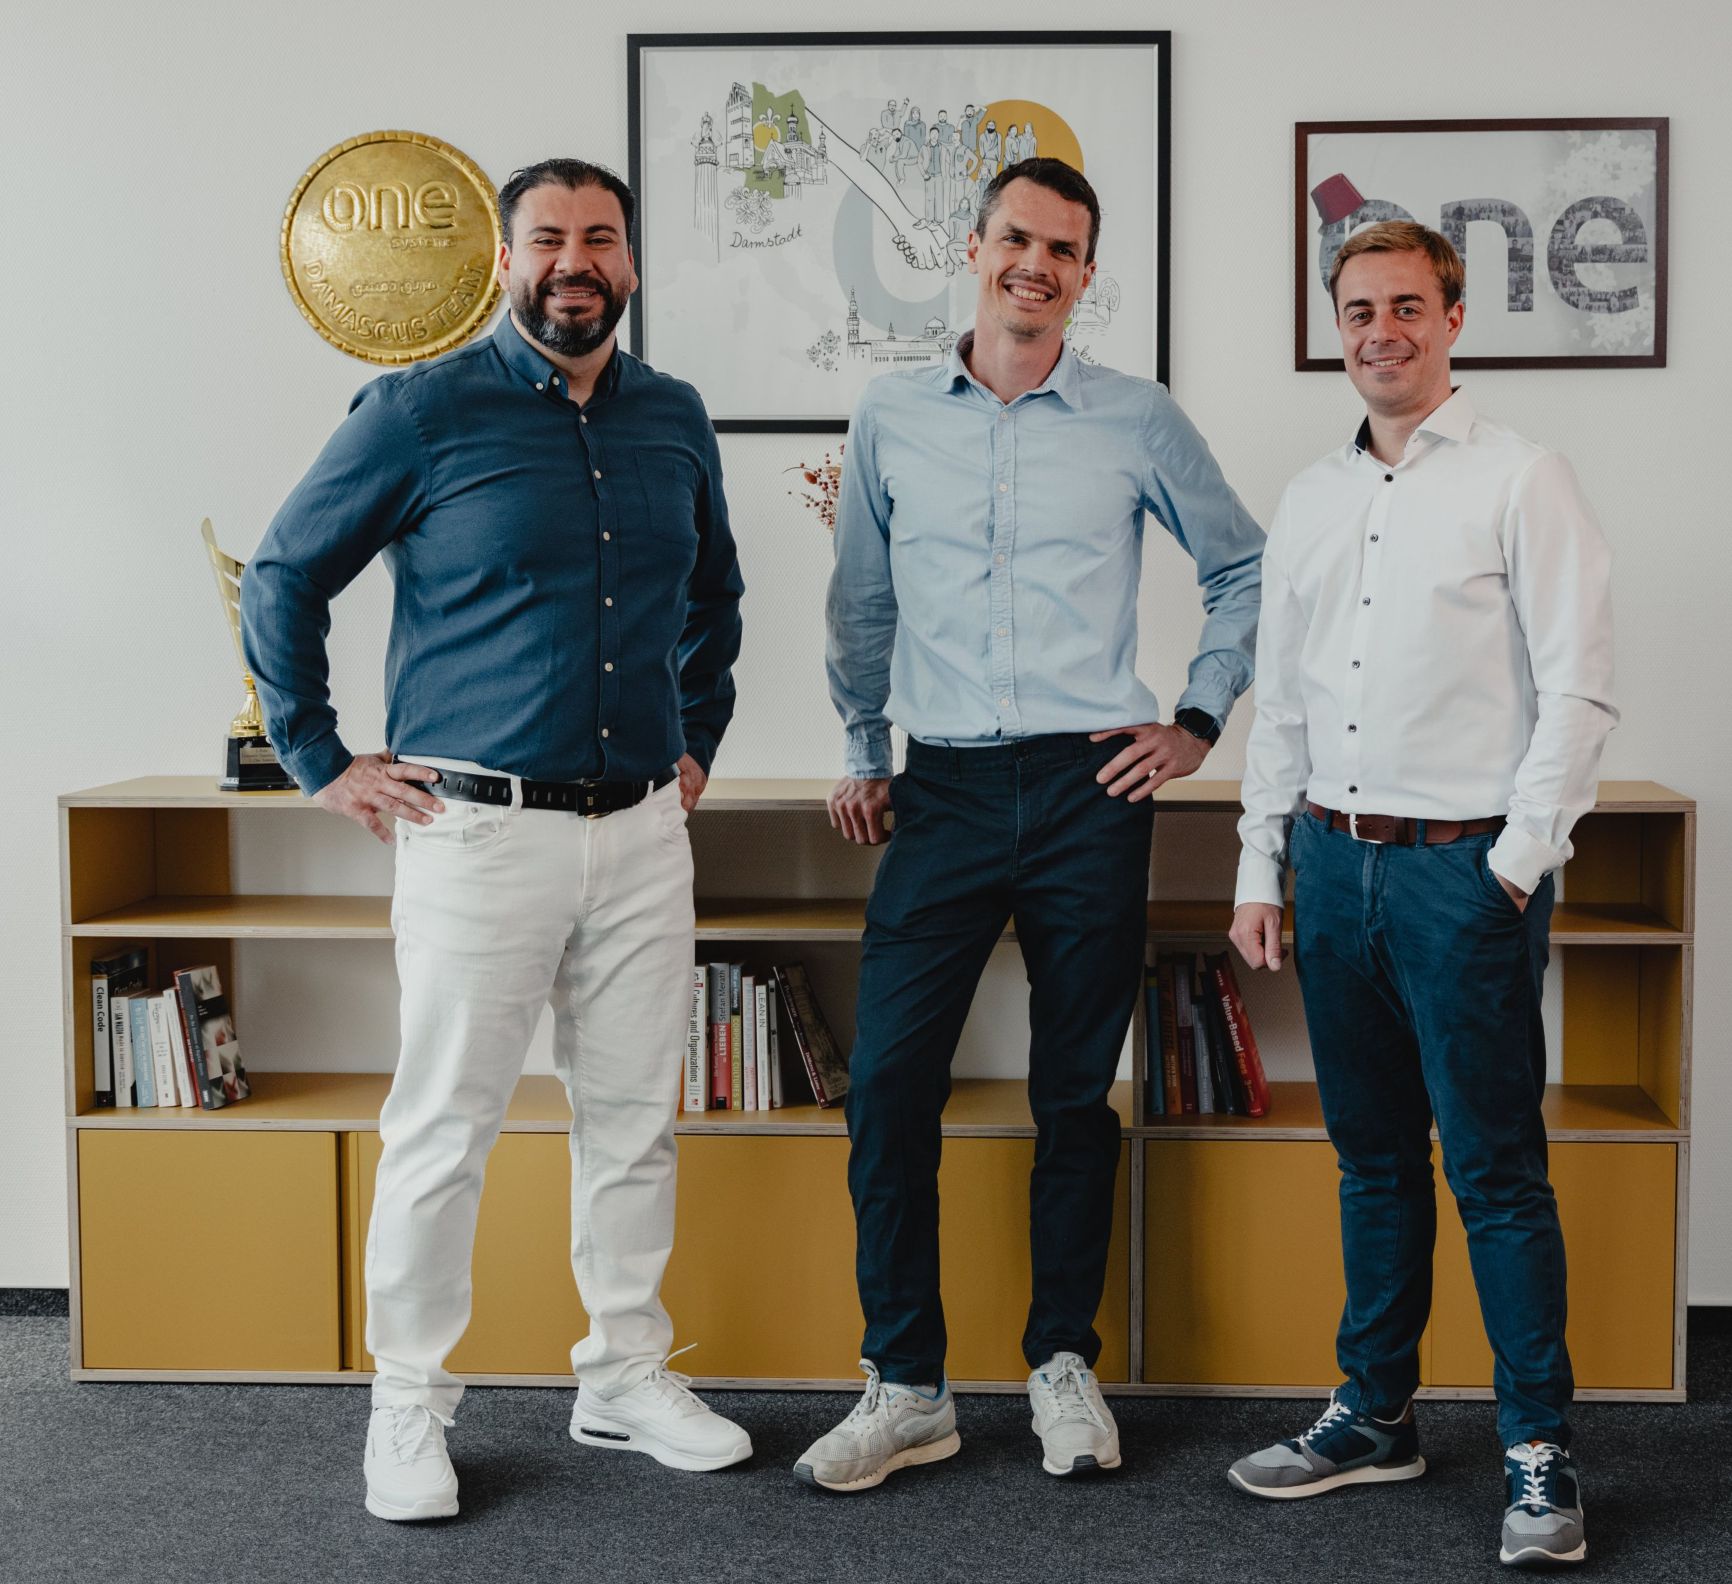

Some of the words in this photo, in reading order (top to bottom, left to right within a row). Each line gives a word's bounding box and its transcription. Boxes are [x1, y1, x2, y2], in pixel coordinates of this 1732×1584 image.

[322, 181, 460, 233] one
[730, 223, 803, 249] Darmstadt
[304, 258, 428, 344] DAMASCUS
[428, 263, 487, 328] TEAM
[96, 986, 105, 1010] Clean
[758, 992, 766, 1016] LEAN
[97, 1011, 106, 1033] Code
[689, 1020, 700, 1034] and
[759, 1018, 766, 1028] IN
[1221, 994, 1244, 1053] Value-Based
[719, 1025, 727, 1056] LIEBEN
[732, 1018, 740, 1058] CORPORATE
[687, 1035, 701, 1083] Organizations
[732, 1061, 740, 1095] CULTURES
